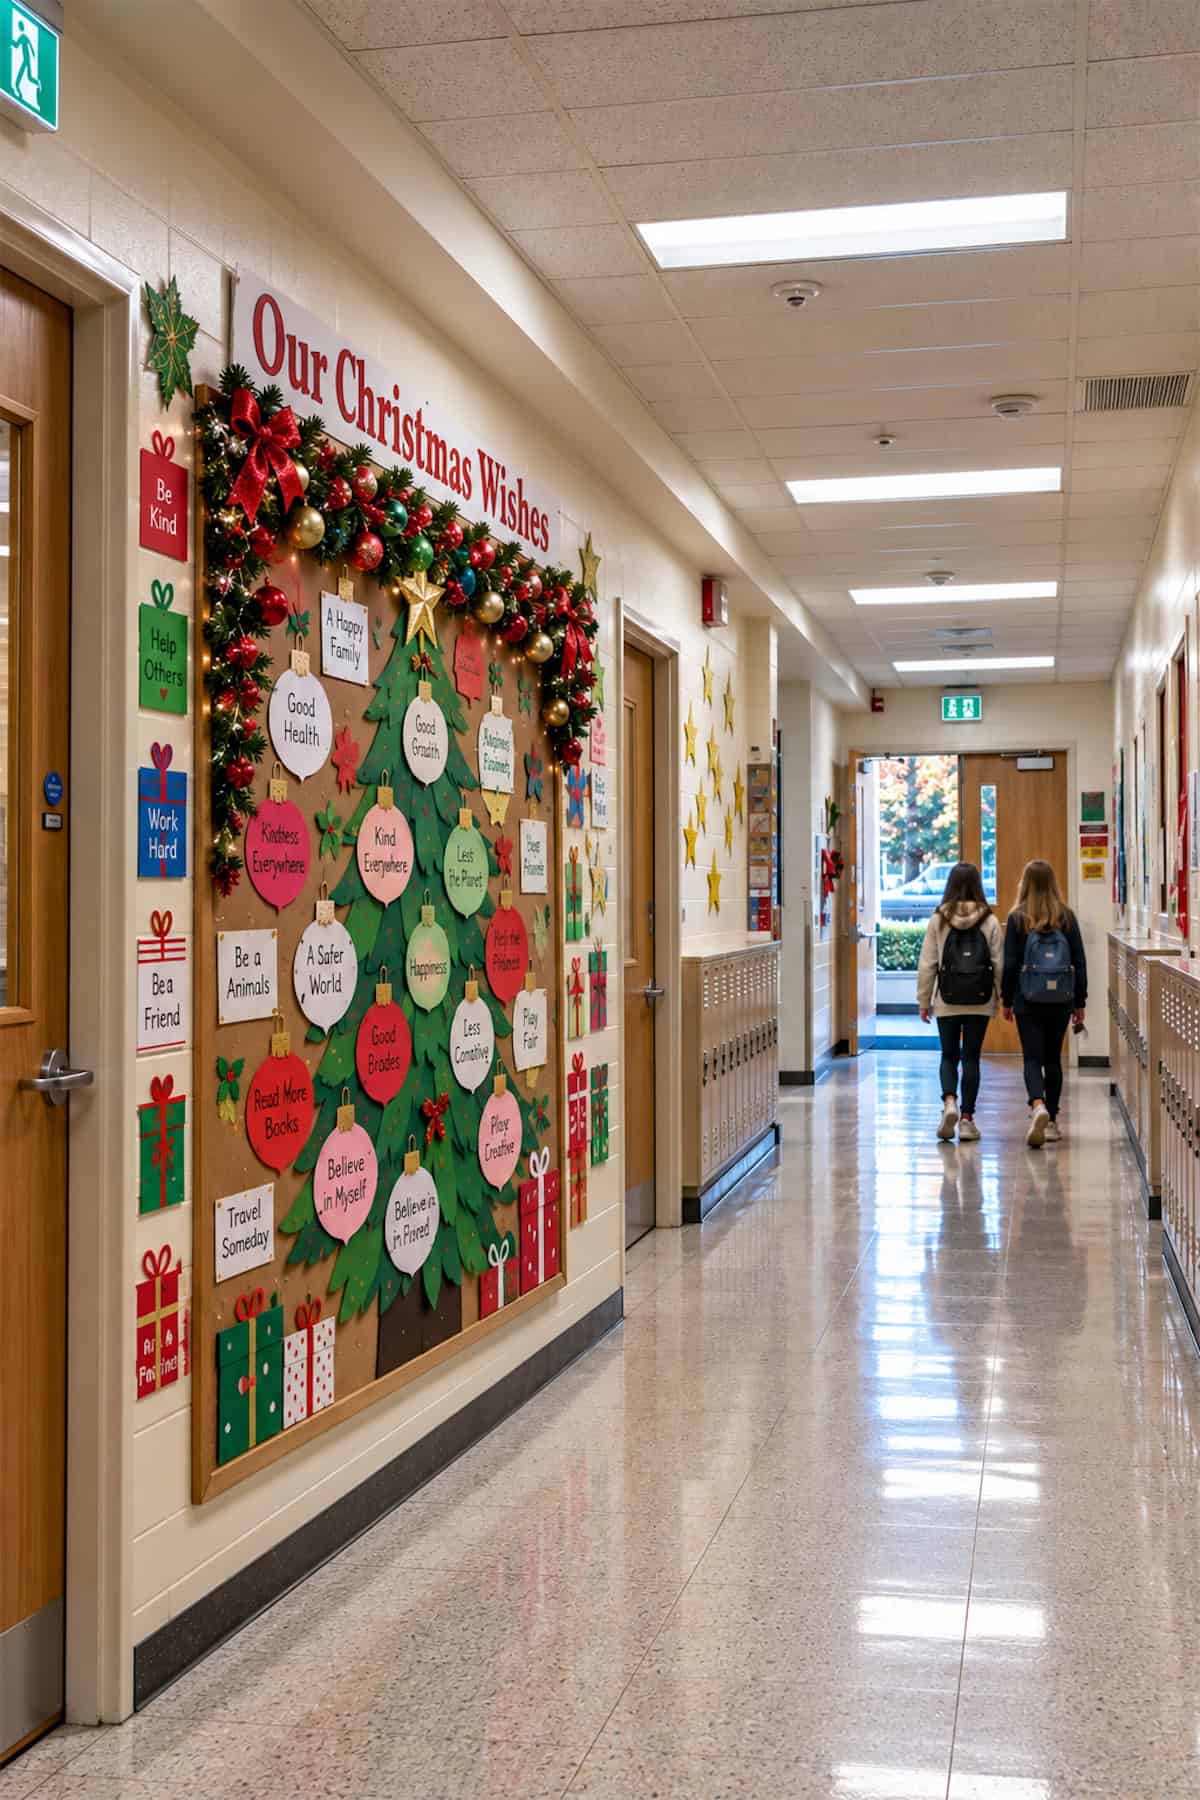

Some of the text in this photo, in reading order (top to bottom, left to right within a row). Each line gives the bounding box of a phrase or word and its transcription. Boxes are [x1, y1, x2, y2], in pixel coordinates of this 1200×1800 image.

[252, 292, 549, 553] Our Christmas Wishes
[156, 478, 172, 504] Be
[150, 504, 177, 535] Kind
[326, 607, 364, 643] A Happy
[151, 626, 176, 661] Help
[330, 636, 361, 671] Family
[144, 658, 184, 687] Others
[287, 692, 315, 718] Good
[284, 720, 320, 746] Health
[416, 714, 436, 735] Good
[147, 807, 178, 832] Work
[149, 837, 177, 859] Hard
[375, 826, 396, 846] Kind
[235, 946, 261, 968] Be a
[306, 943, 345, 966] A Safer
[152, 973, 173, 995] Be a
[226, 974, 270, 1000] Animals
[309, 972, 342, 996] World
[144, 1003, 180, 1031] Friend
[371, 1024, 396, 1046] Good
[254, 1079, 307, 1112] Read More
[264, 1113, 299, 1140] Books
[327, 1155, 365, 1180] Believe
[323, 1178, 367, 1212] in Myself
[227, 1198, 261, 1229] Travel
[222, 1228, 270, 1259] Someday
